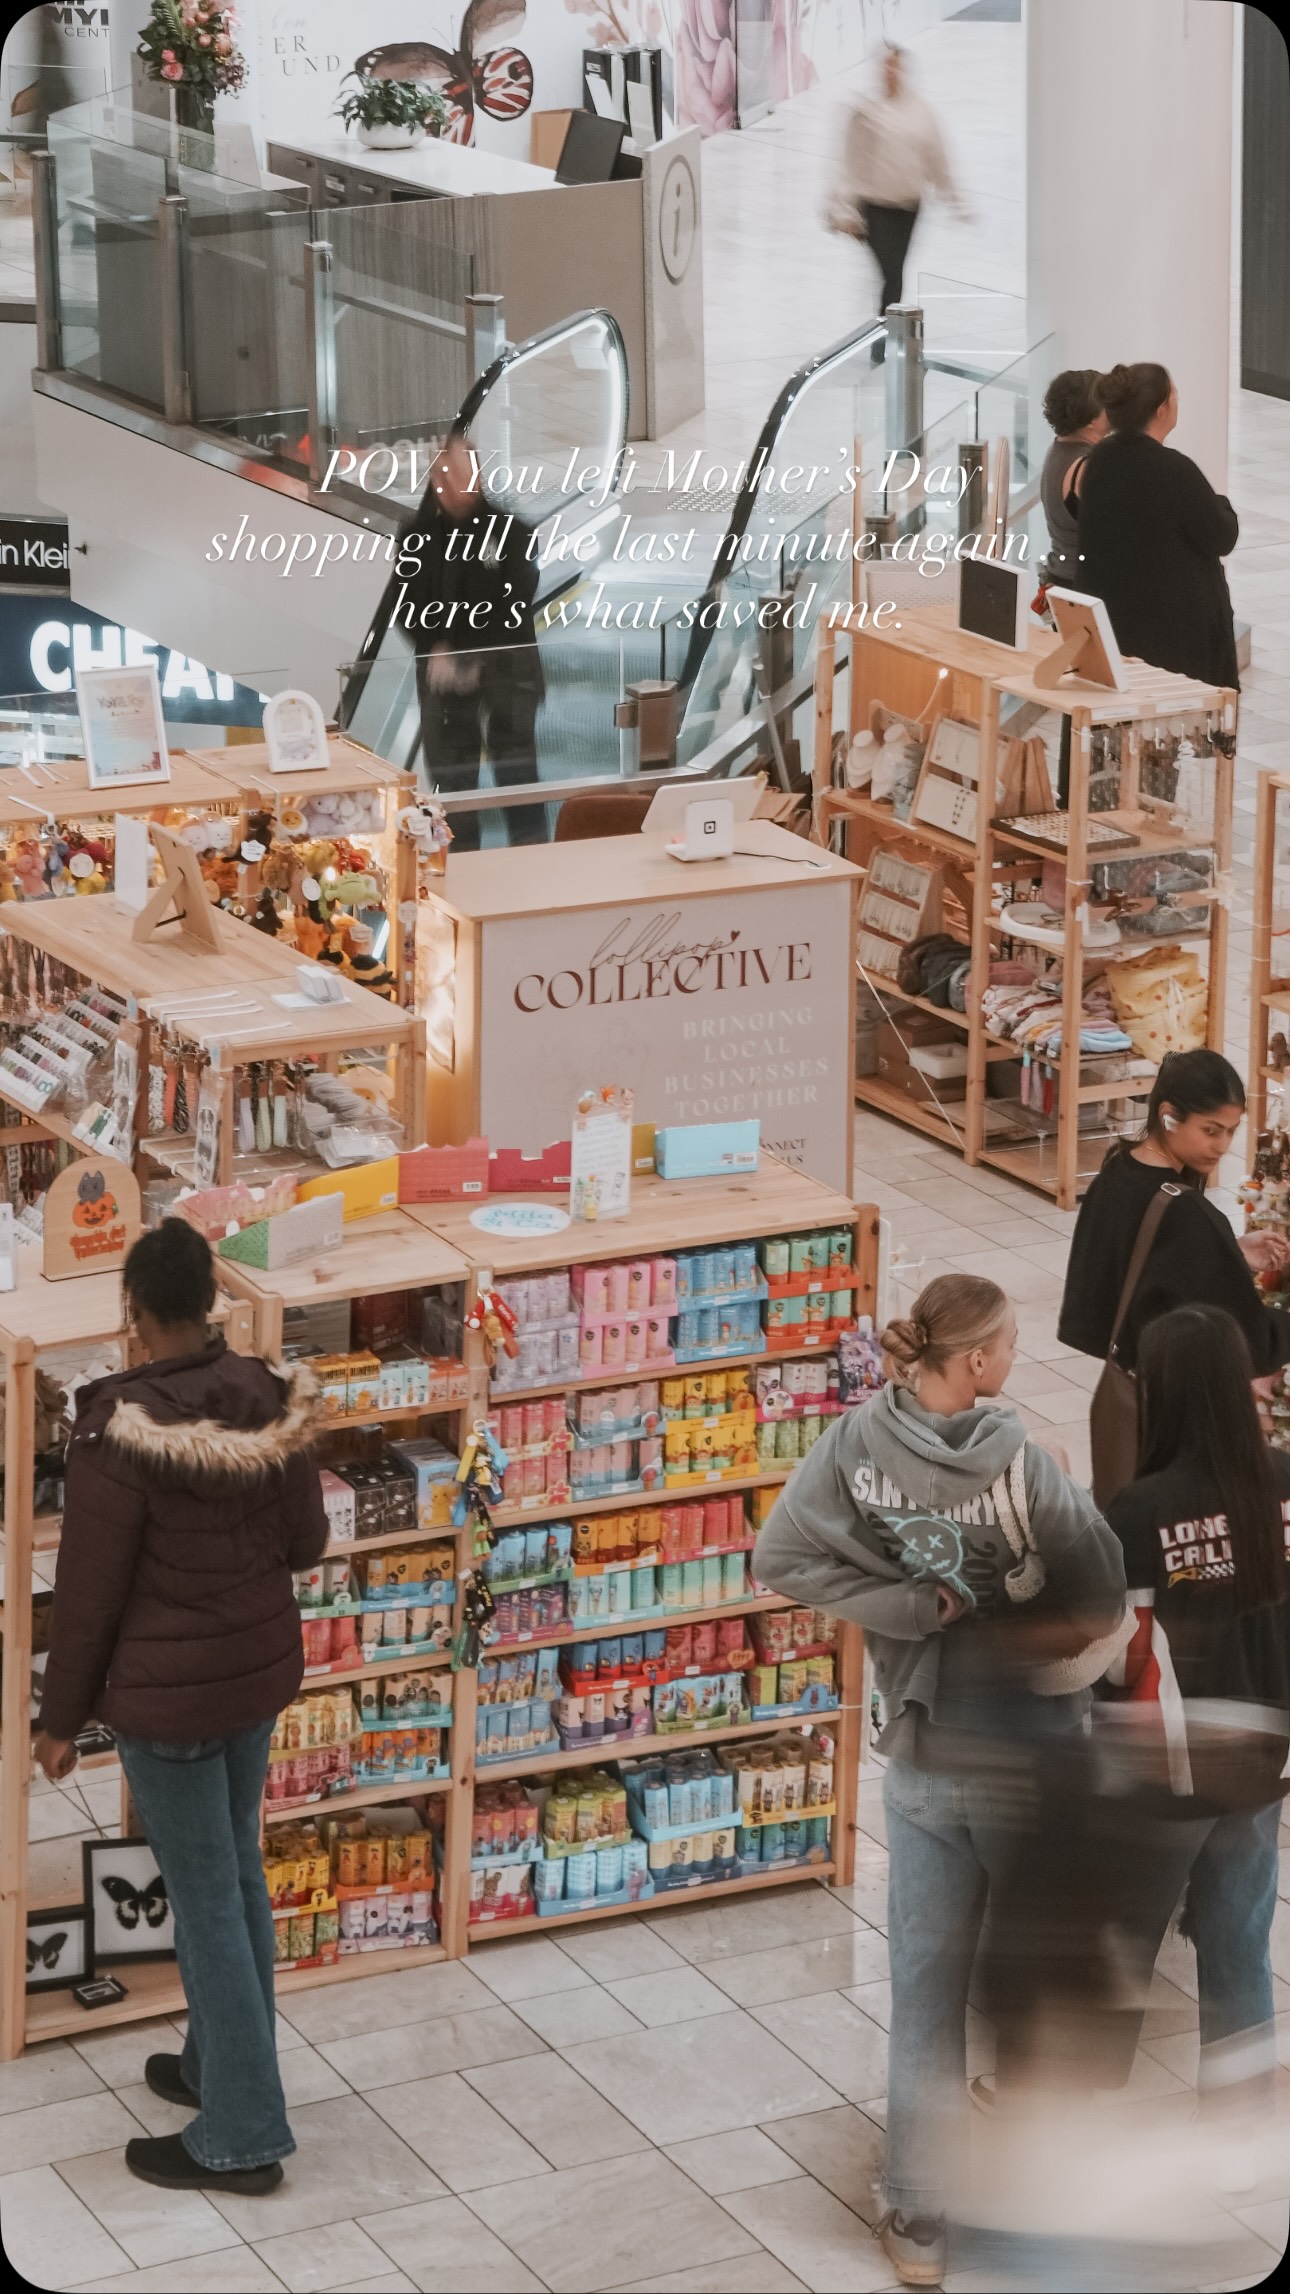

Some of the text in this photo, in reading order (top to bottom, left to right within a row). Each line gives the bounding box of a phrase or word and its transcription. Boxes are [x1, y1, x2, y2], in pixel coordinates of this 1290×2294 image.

[589, 911, 732, 986] lollipop
[513, 942, 812, 1013] COLLECTIVE
[683, 1007, 813, 1040] BRINGING
[704, 1036, 791, 1064] LOCAL
[665, 1056, 829, 1095] BUSINESSES
[674, 1085, 819, 1120] TOGETHER
